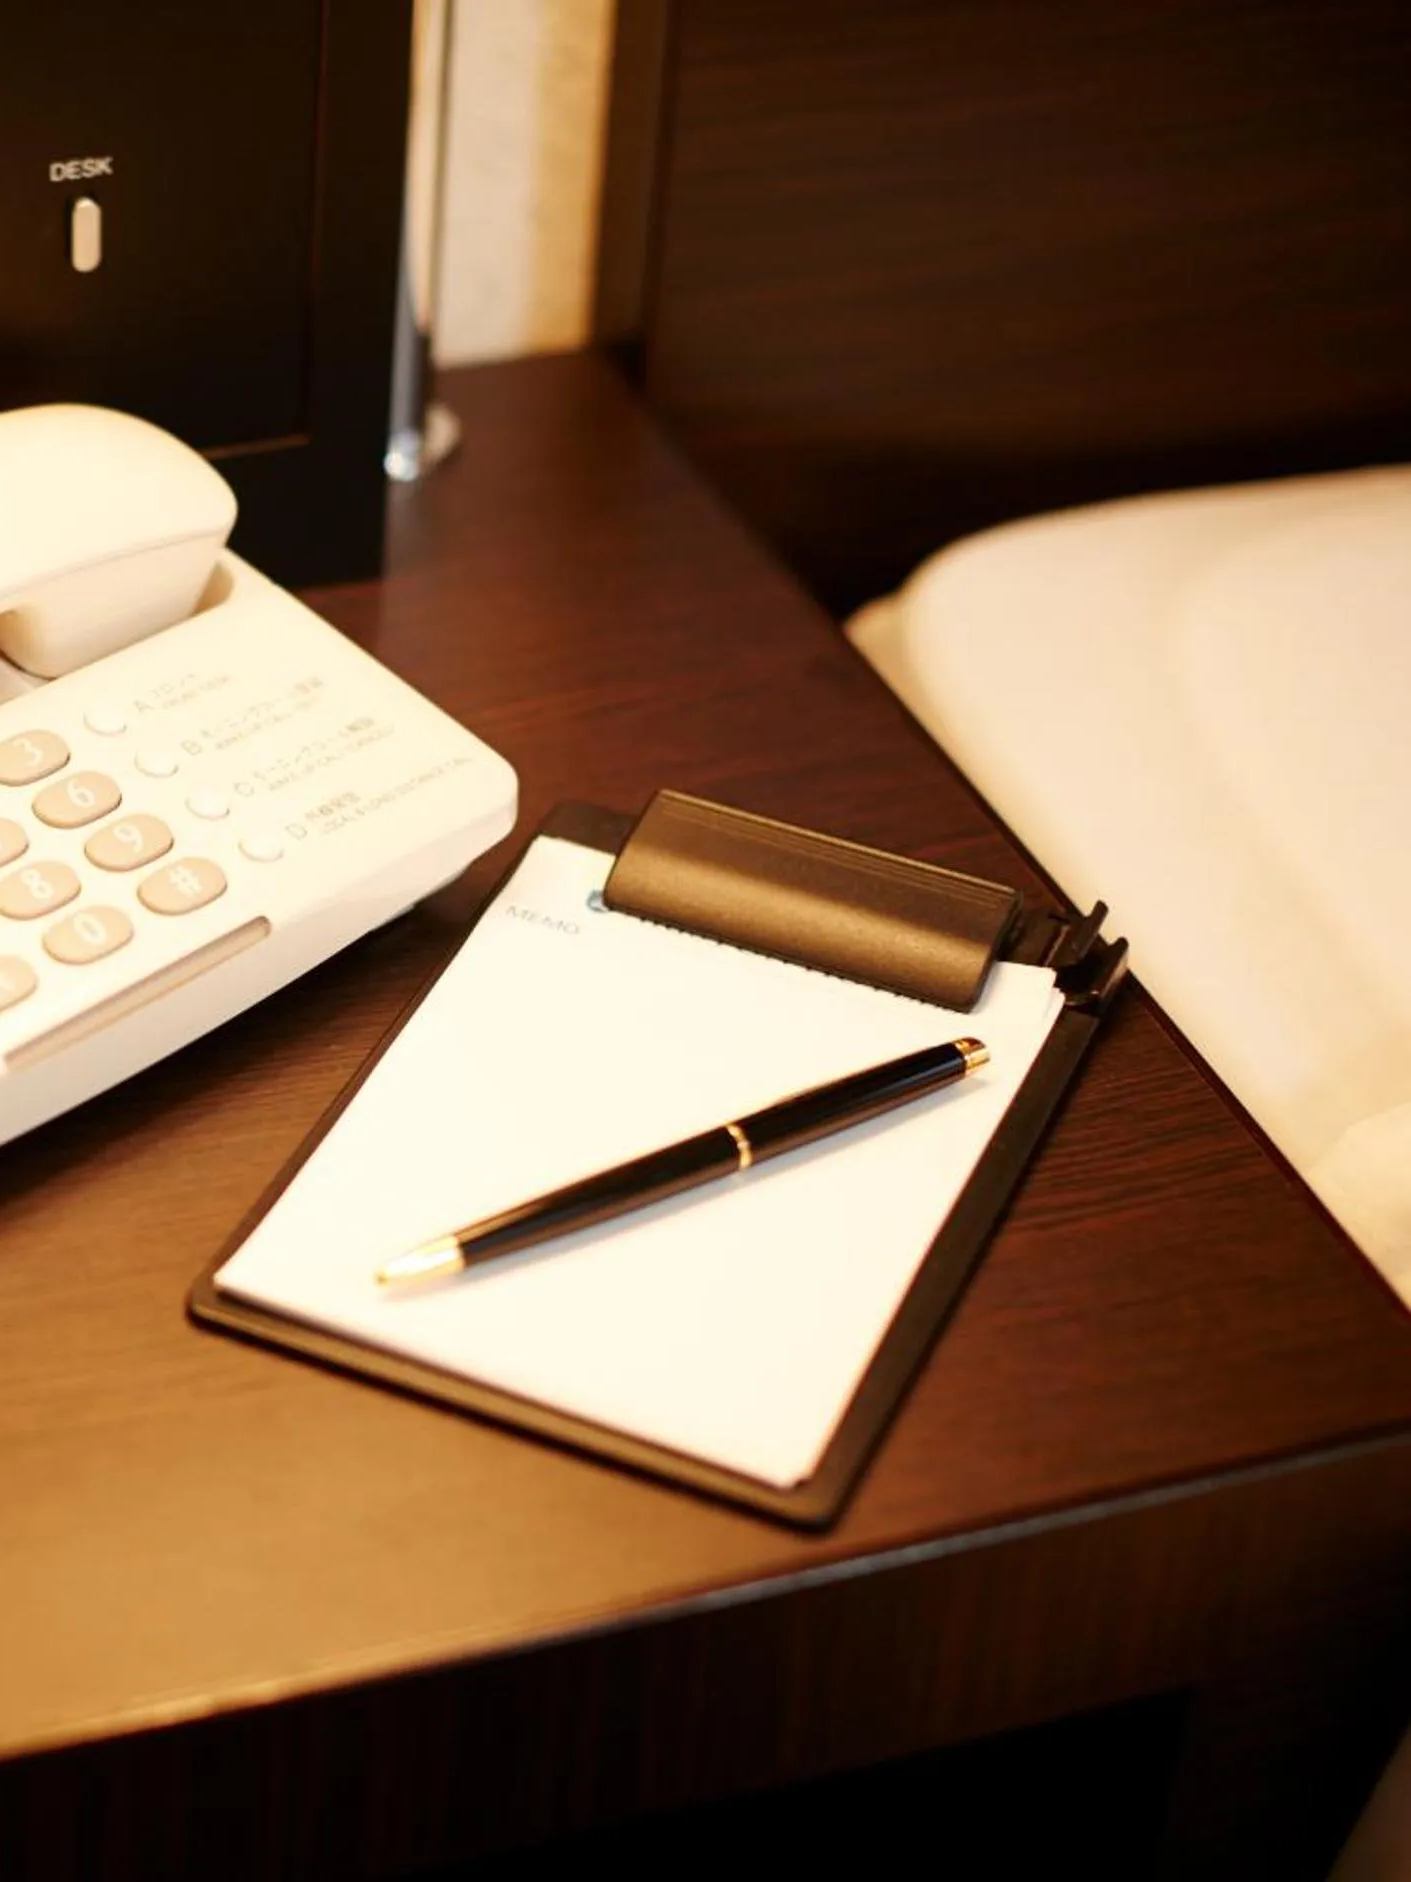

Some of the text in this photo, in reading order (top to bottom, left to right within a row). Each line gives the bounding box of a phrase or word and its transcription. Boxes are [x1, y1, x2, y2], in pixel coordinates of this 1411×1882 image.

[49, 157, 114, 182] DESK
[12, 739, 43, 766] 3
[67, 779, 96, 807] 6
[20, 869, 52, 900] 8
[112, 822, 144, 852] 9
[73, 913, 106, 945] 0
[168, 866, 201, 897] #
[506, 905, 580, 935] MEMO
